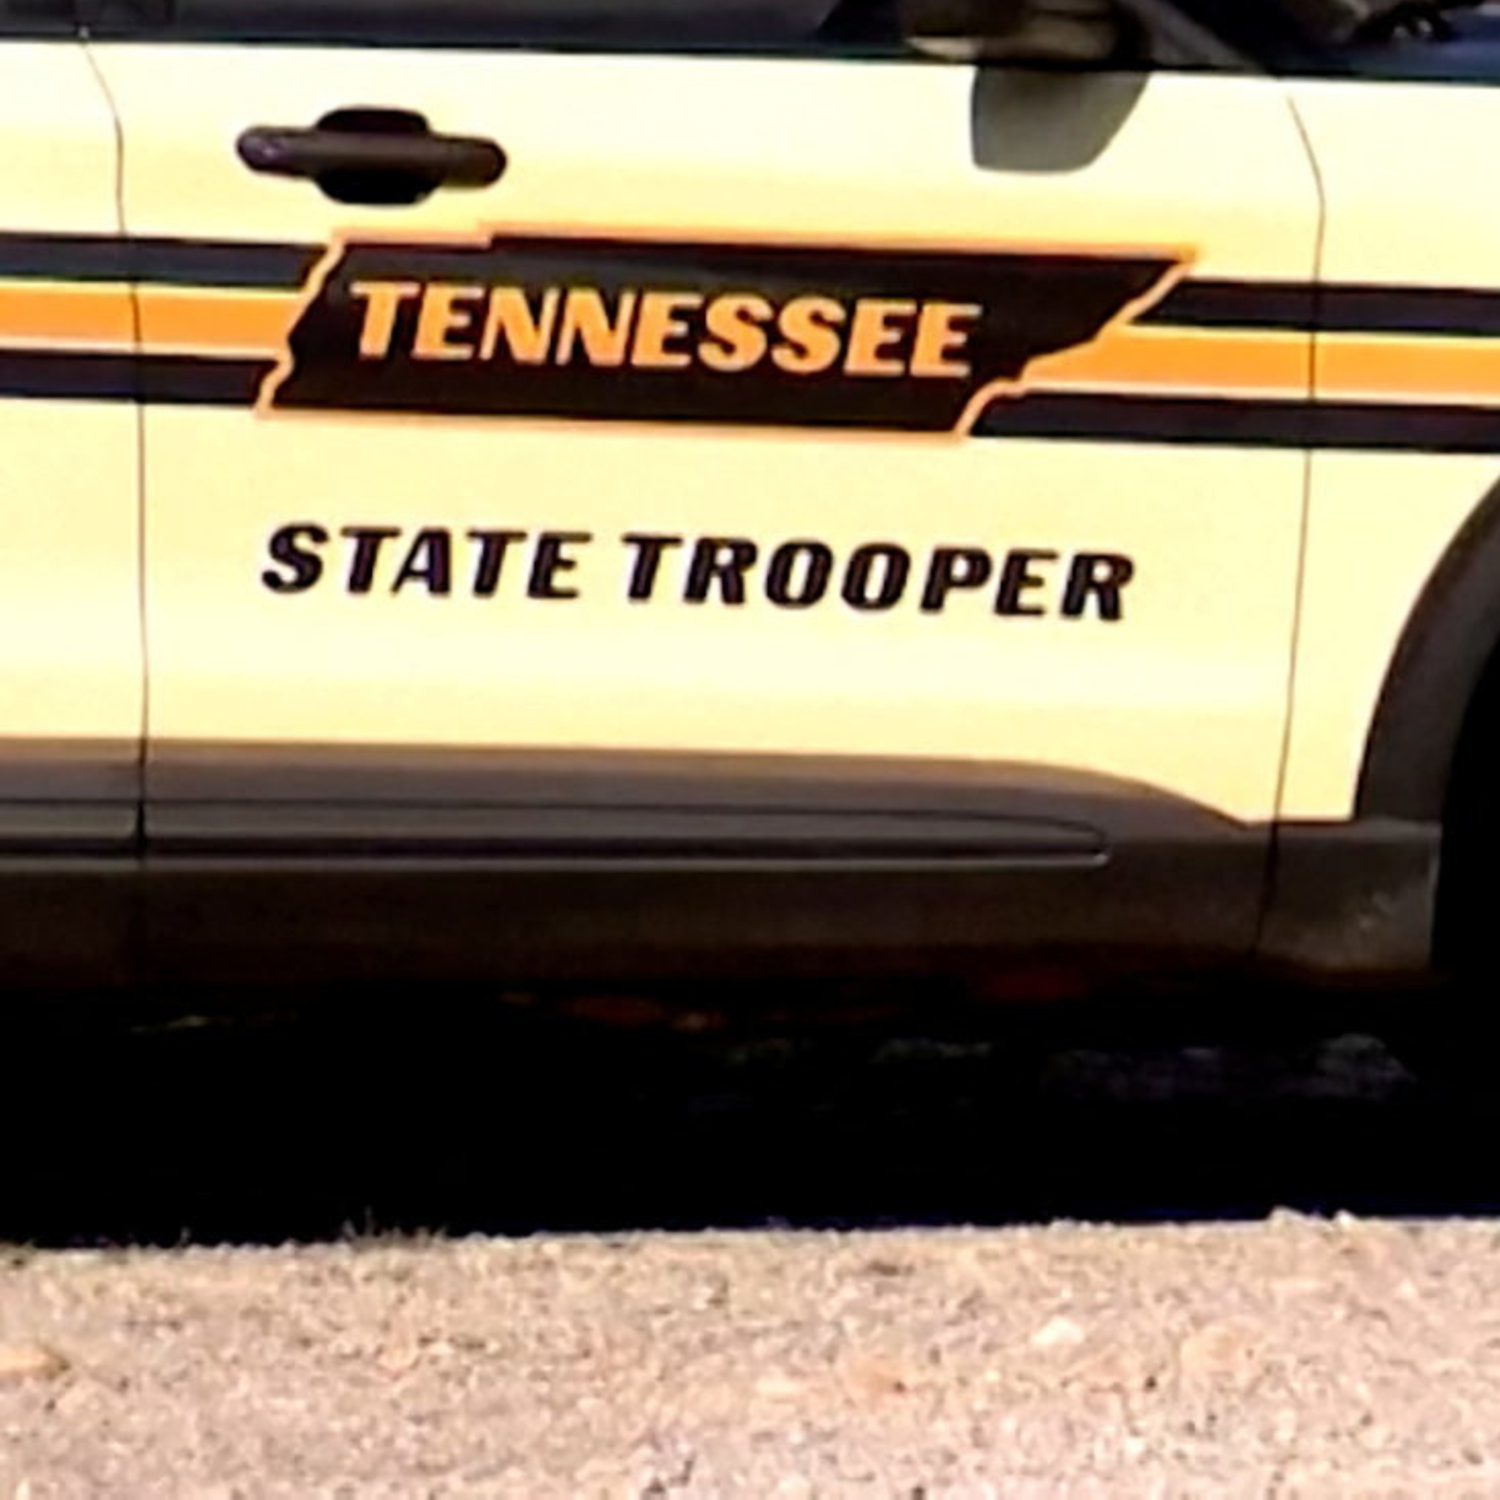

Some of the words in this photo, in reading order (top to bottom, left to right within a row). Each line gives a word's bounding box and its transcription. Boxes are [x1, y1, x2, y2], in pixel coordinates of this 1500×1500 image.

[350, 280, 982, 378] TENNESSEE
[261, 524, 592, 599] STATE
[621, 533, 1134, 622] TROOPER
